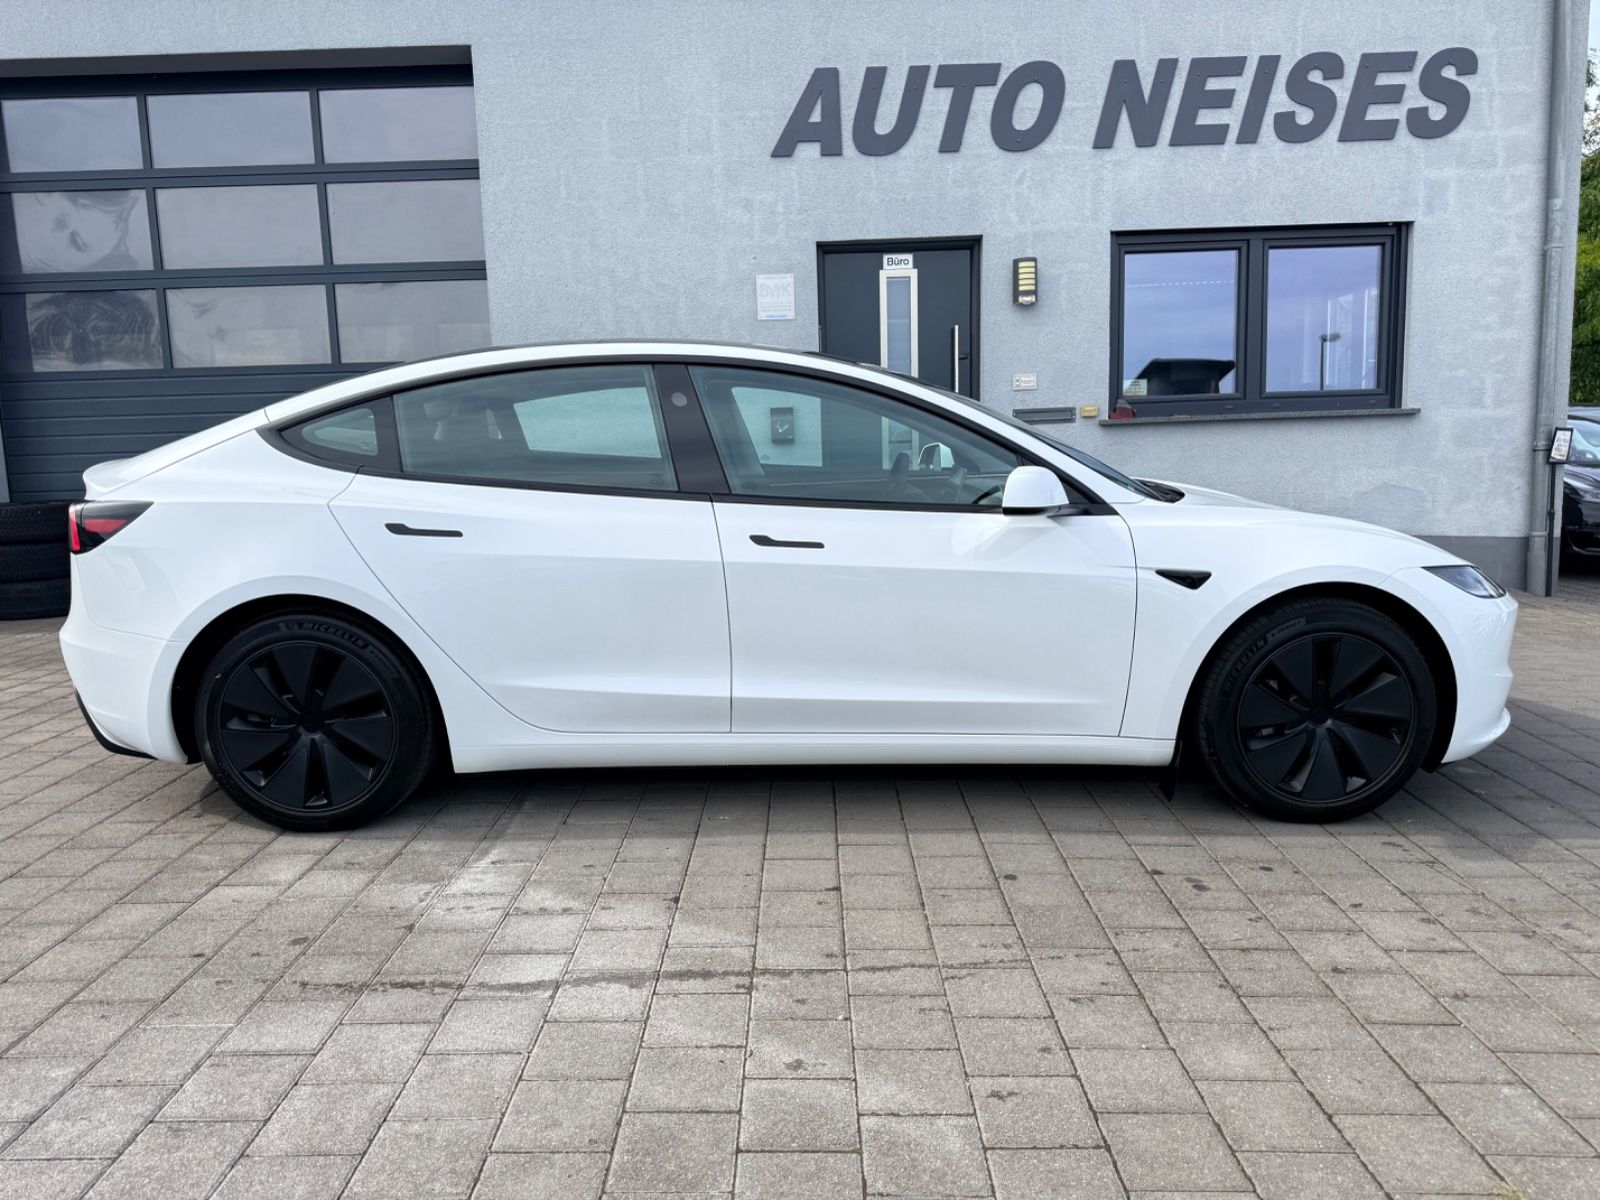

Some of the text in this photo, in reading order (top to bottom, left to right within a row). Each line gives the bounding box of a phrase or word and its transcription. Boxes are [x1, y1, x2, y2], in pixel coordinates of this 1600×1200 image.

[770, 46, 1479, 158] AUTO NEISES
[886, 256, 910, 266] Büro
[302, 621, 369, 650] MICHELIN
